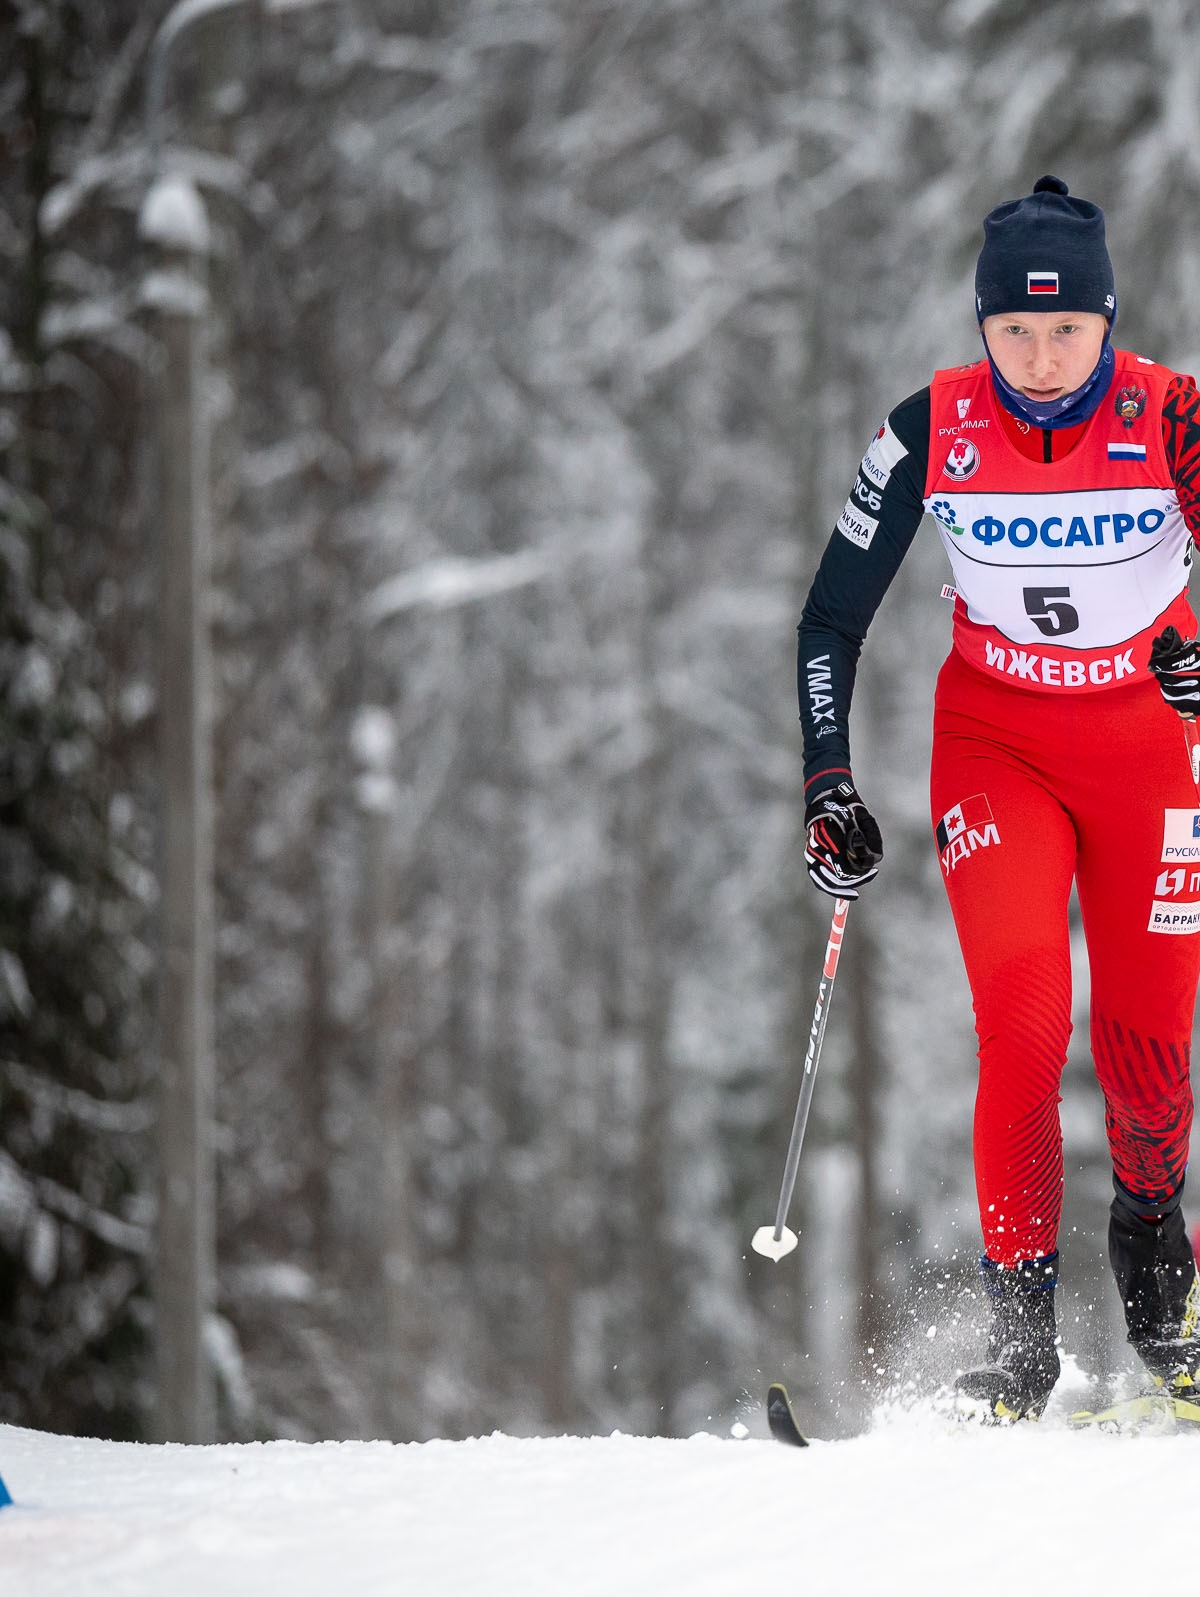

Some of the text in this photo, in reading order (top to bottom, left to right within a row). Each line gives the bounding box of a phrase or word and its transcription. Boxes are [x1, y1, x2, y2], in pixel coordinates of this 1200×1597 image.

[938, 419, 991, 437] РУСИМАТ
[971, 508, 1166, 549] ФОСАГРО
[1022, 586, 1079, 637] 5
[984, 639, 1137, 687] ИЖЕВСК
[806, 654, 836, 724] VMAX
[941, 823, 1002, 877] УДМ
